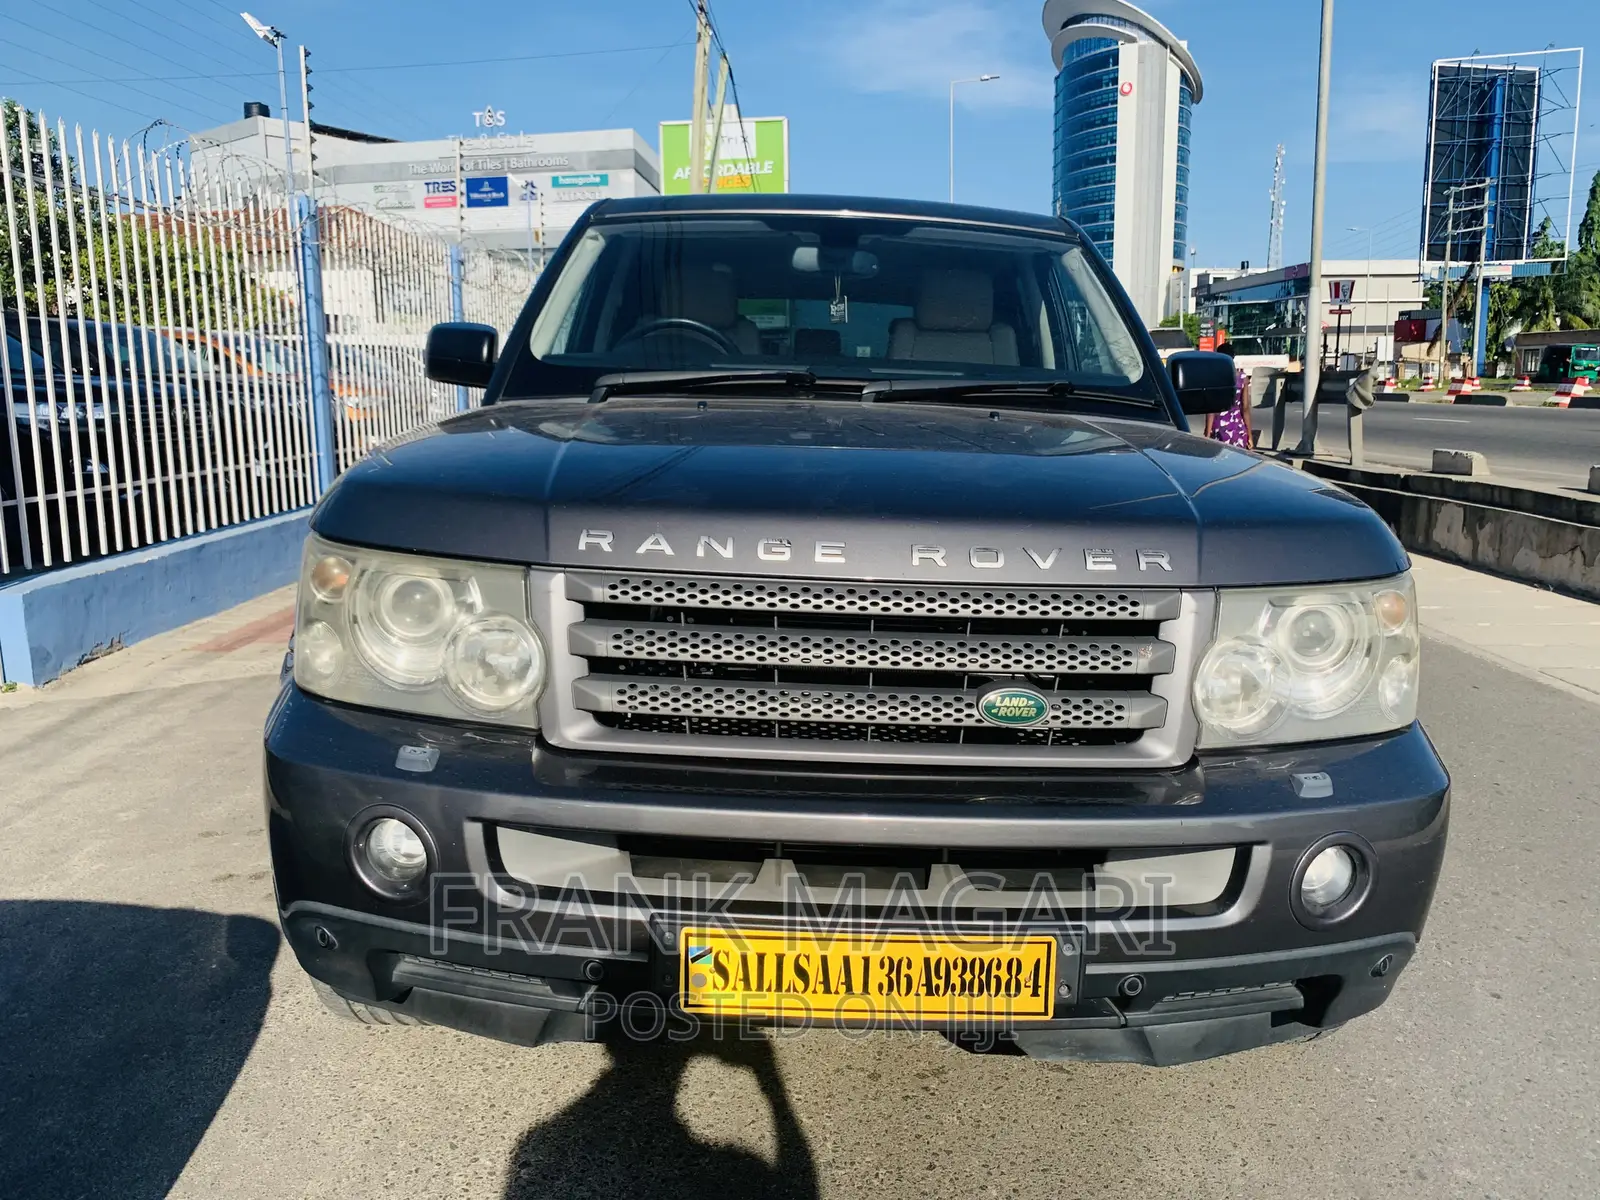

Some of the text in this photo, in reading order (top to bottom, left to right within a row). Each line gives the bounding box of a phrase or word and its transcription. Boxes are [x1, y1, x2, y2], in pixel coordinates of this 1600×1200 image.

[472, 105, 506, 128] T&S
[408, 163, 428, 175] The
[464, 159, 475, 172] of
[478, 157, 502, 171] Tiles
[510, 155, 569, 169] Bathrooms
[424, 180, 457, 195] TRES
[578, 529, 1174, 572] RANGE ROVER
[995, 696, 1027, 707] LAND
[998, 706, 1038, 717] ROVER
